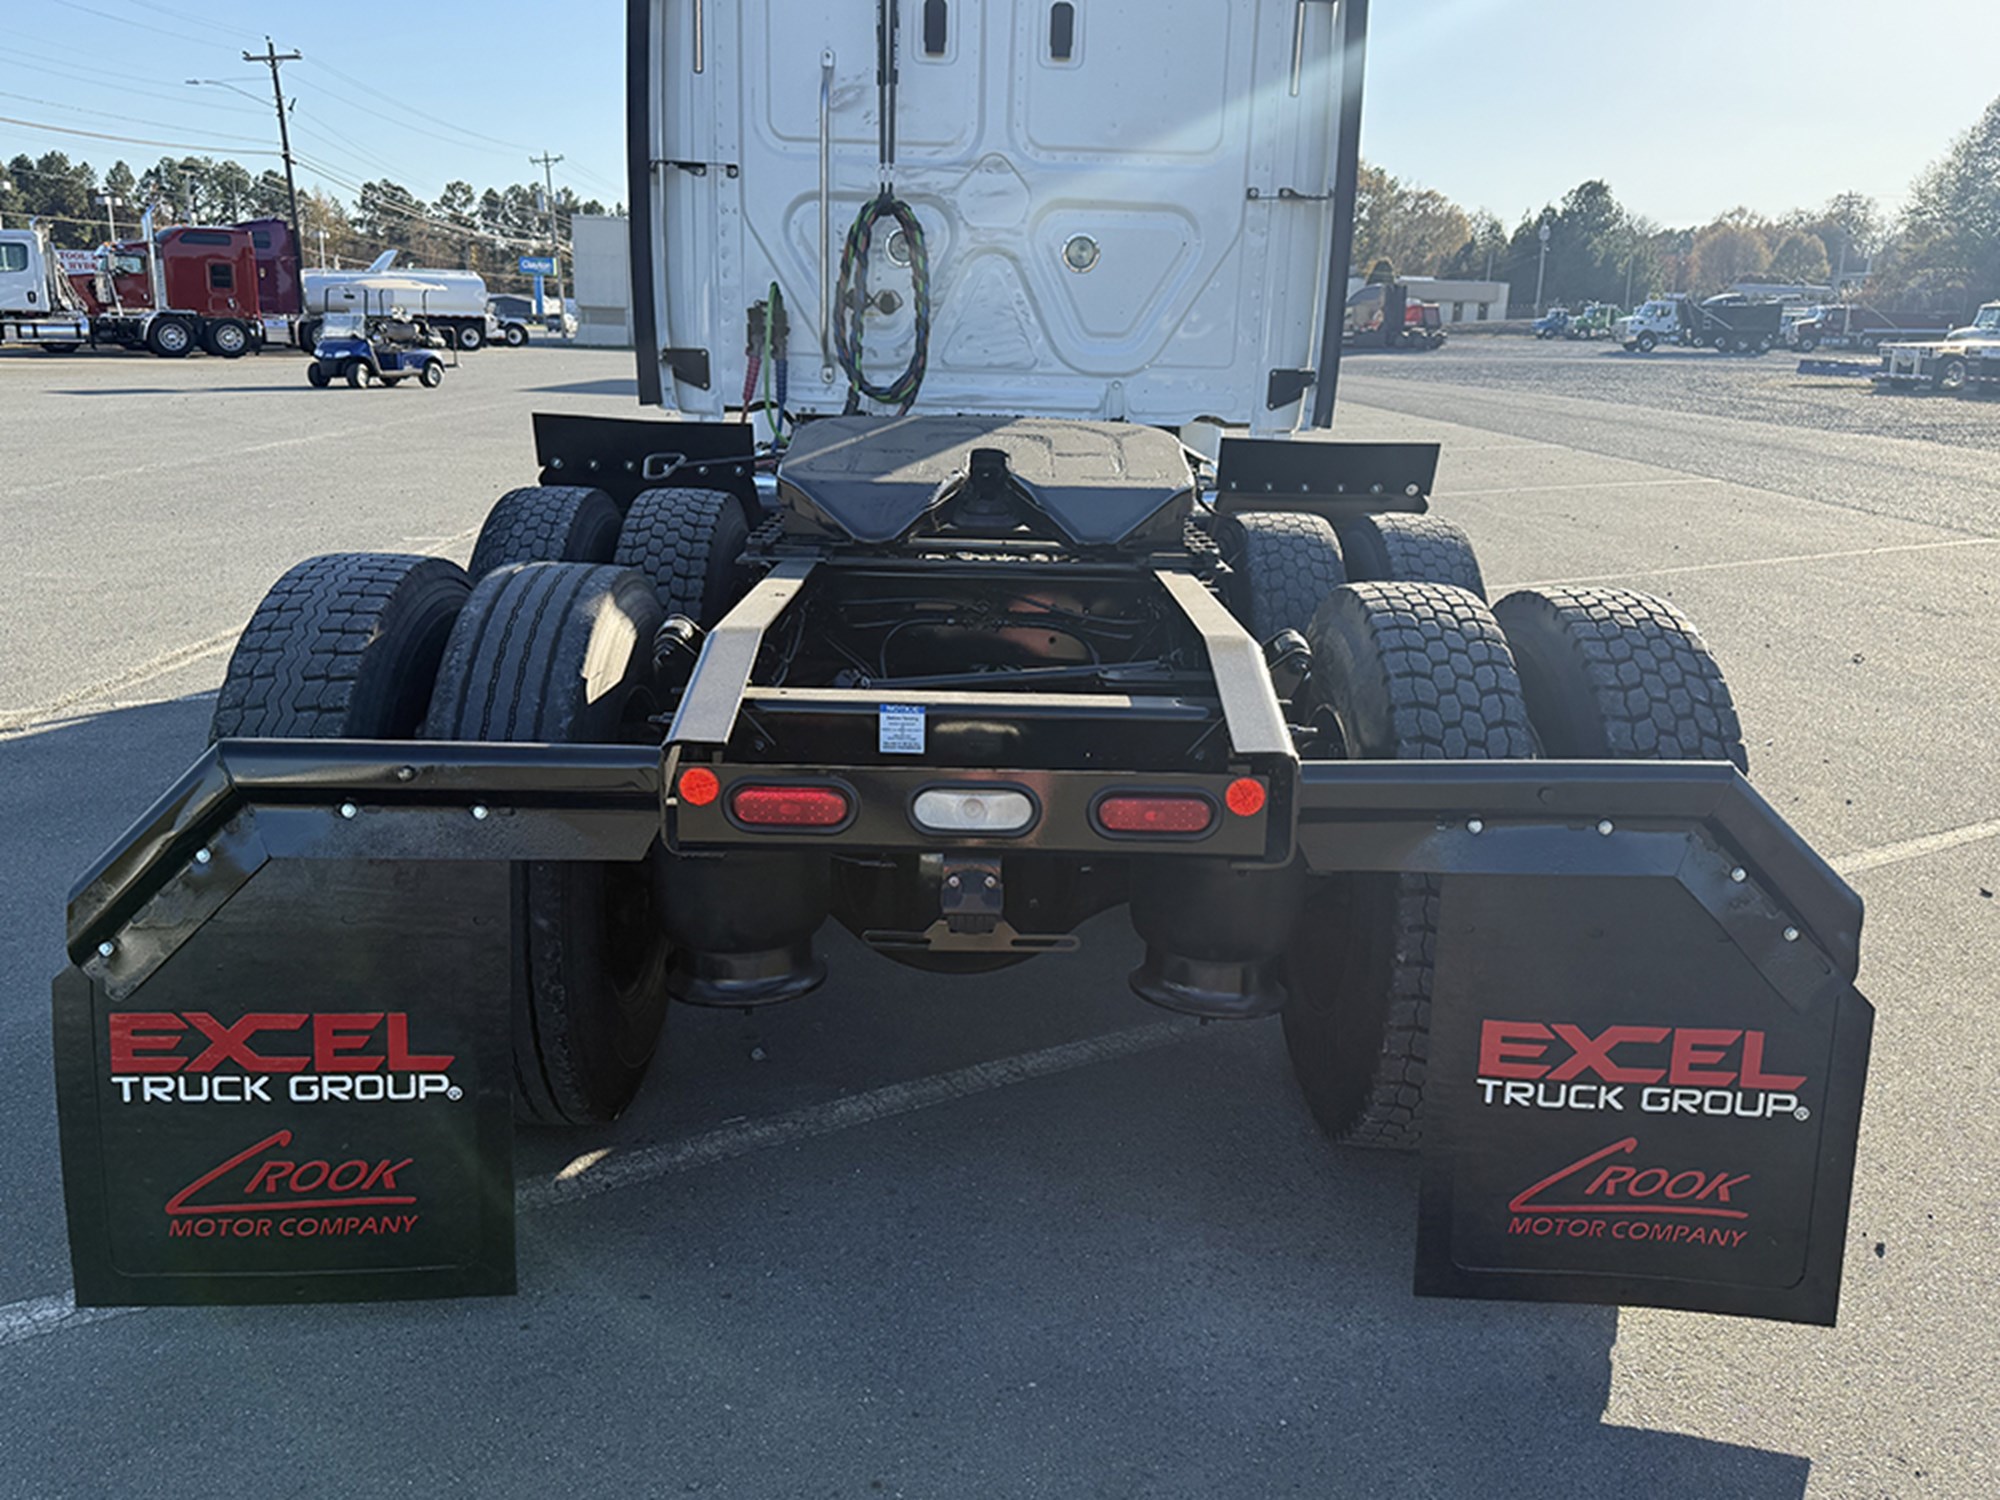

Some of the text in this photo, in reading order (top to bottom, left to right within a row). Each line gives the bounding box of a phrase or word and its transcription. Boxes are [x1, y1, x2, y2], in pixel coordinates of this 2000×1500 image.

[109, 1013, 455, 1073] EXCEL
[1477, 1020, 1807, 1091] EXCEL
[111, 1075, 271, 1102] TRUCK
[1476, 1078, 1624, 1111] TRUCK
[169, 1214, 418, 1237] MOTOR COMPANY
[1508, 1216, 1748, 1248] MOTOR COMPANY
